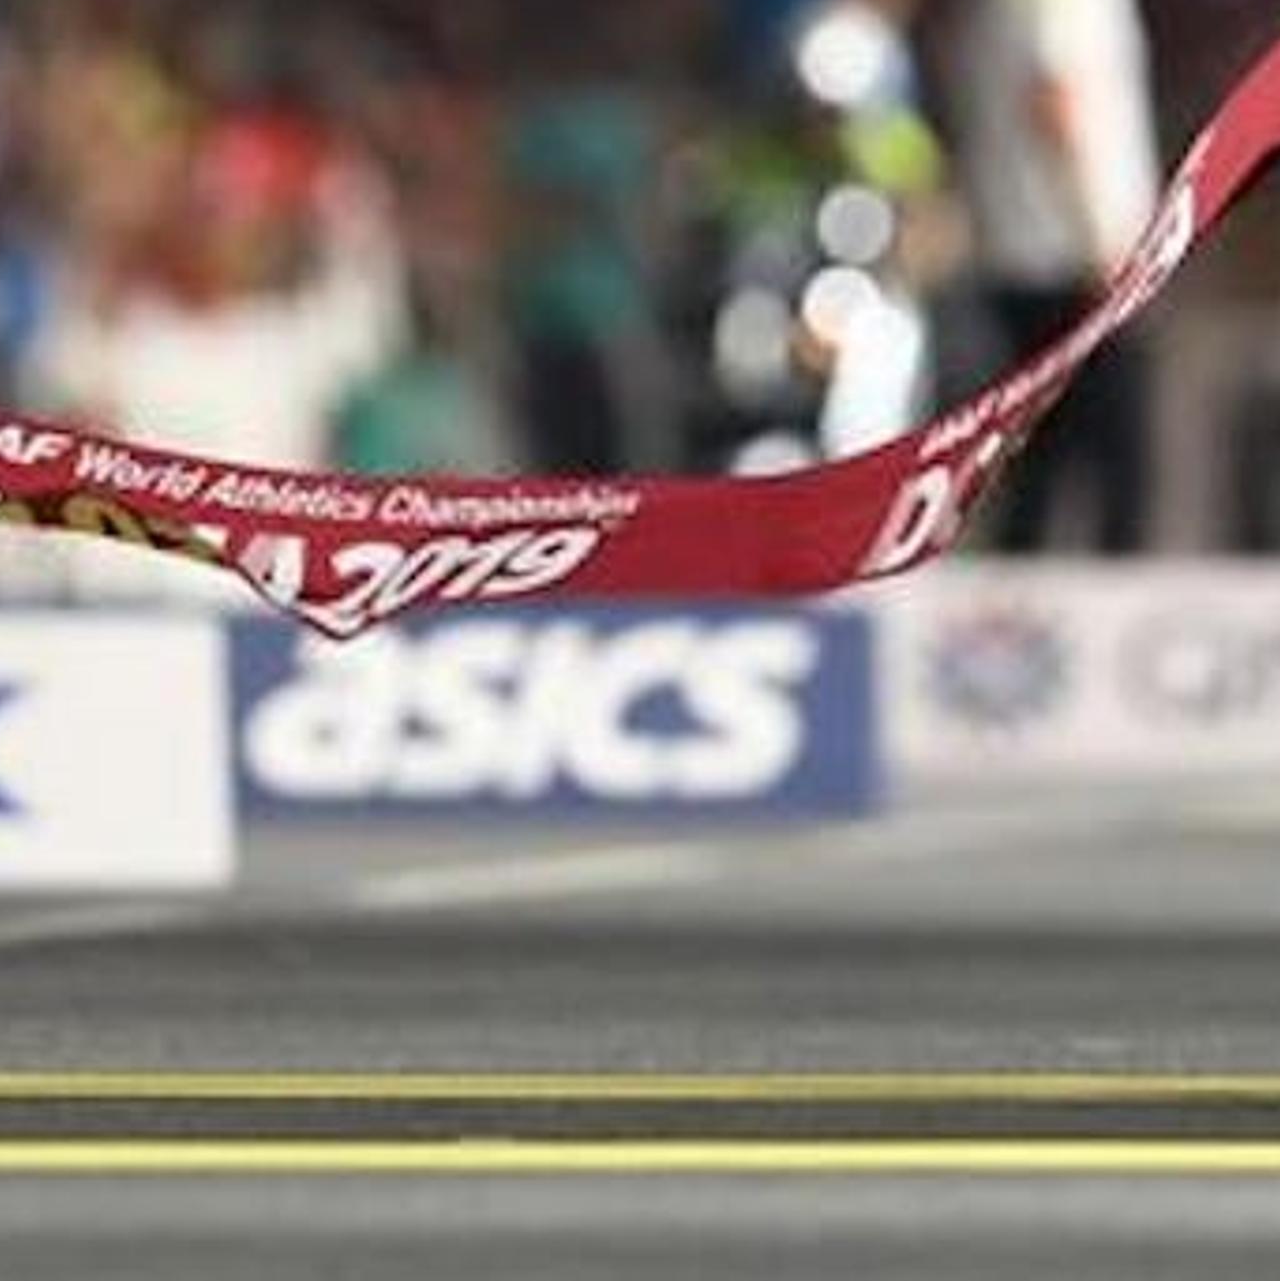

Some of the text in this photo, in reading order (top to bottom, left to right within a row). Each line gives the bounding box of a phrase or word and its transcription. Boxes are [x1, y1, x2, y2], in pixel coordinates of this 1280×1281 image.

[73, 443, 201, 499] World
[202, 471, 373, 521] Athletics
[378, 482, 642, 531] Championships
